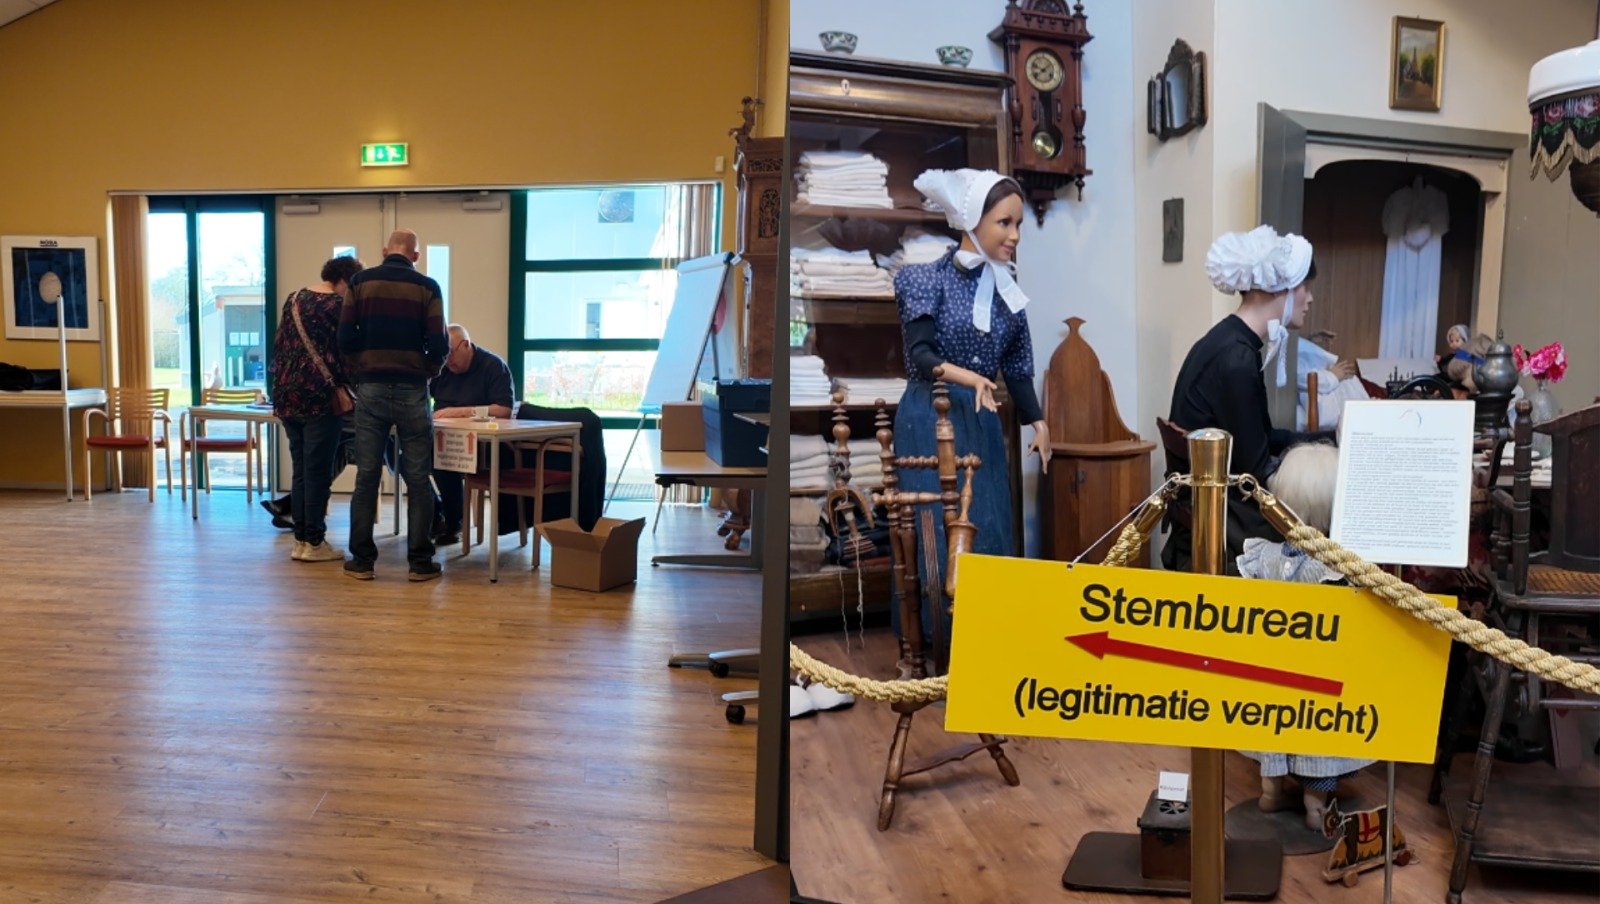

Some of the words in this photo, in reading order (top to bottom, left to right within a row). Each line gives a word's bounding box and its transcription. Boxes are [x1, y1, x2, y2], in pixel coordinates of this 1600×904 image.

[1080, 583, 1340, 642] Stembureau
[1014, 677, 1209, 721] (legitimatie
[1222, 699, 1379, 742] verplicht)
